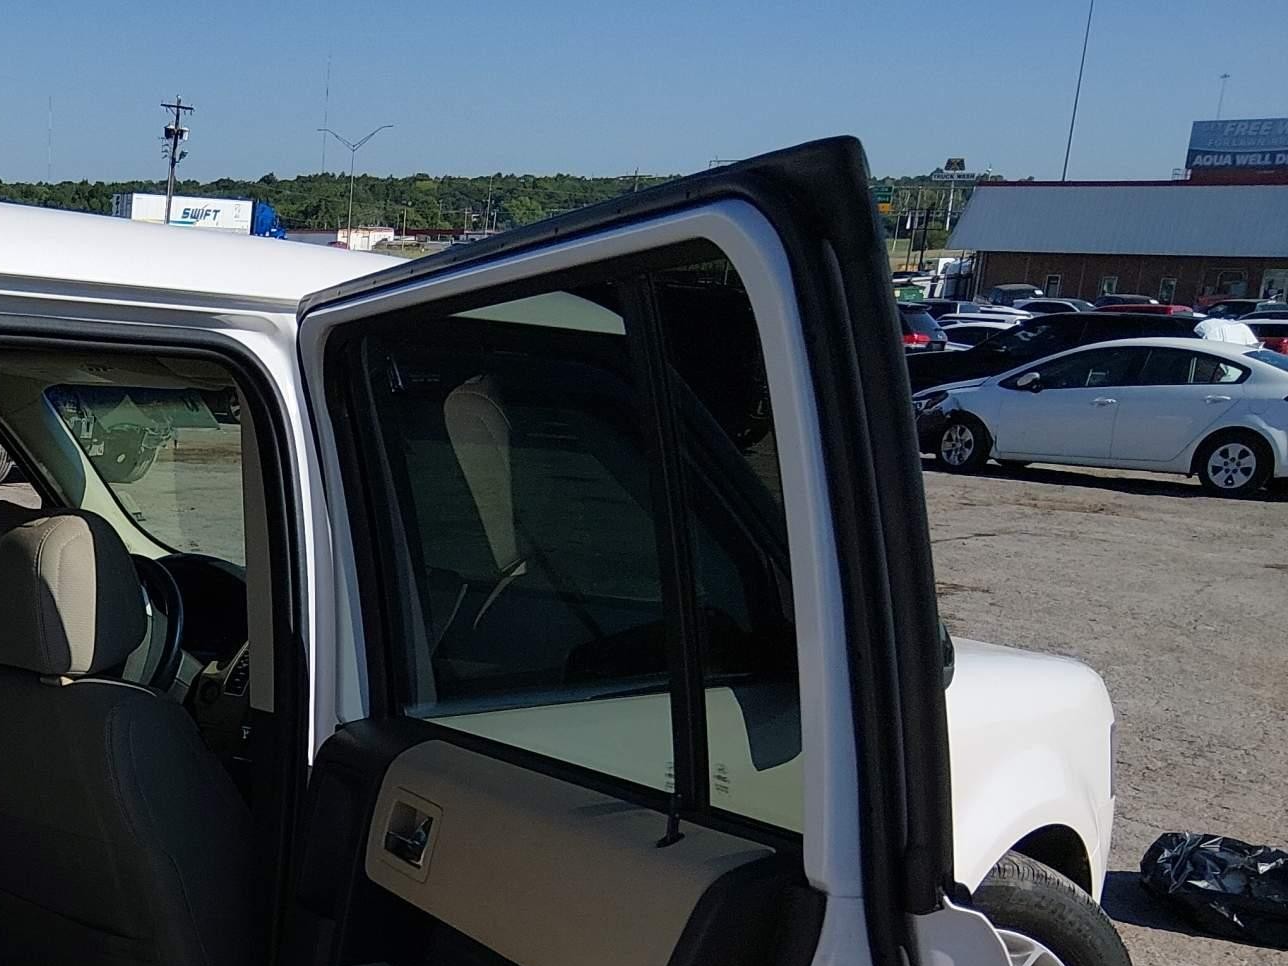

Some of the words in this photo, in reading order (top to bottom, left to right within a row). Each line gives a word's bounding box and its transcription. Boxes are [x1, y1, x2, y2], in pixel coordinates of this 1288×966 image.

[1223, 121, 1273, 136] FREE
[1193, 154, 1232, 166] AQUA
[1235, 153, 1272, 165] WELL
[181, 204, 220, 221] SWIFT
